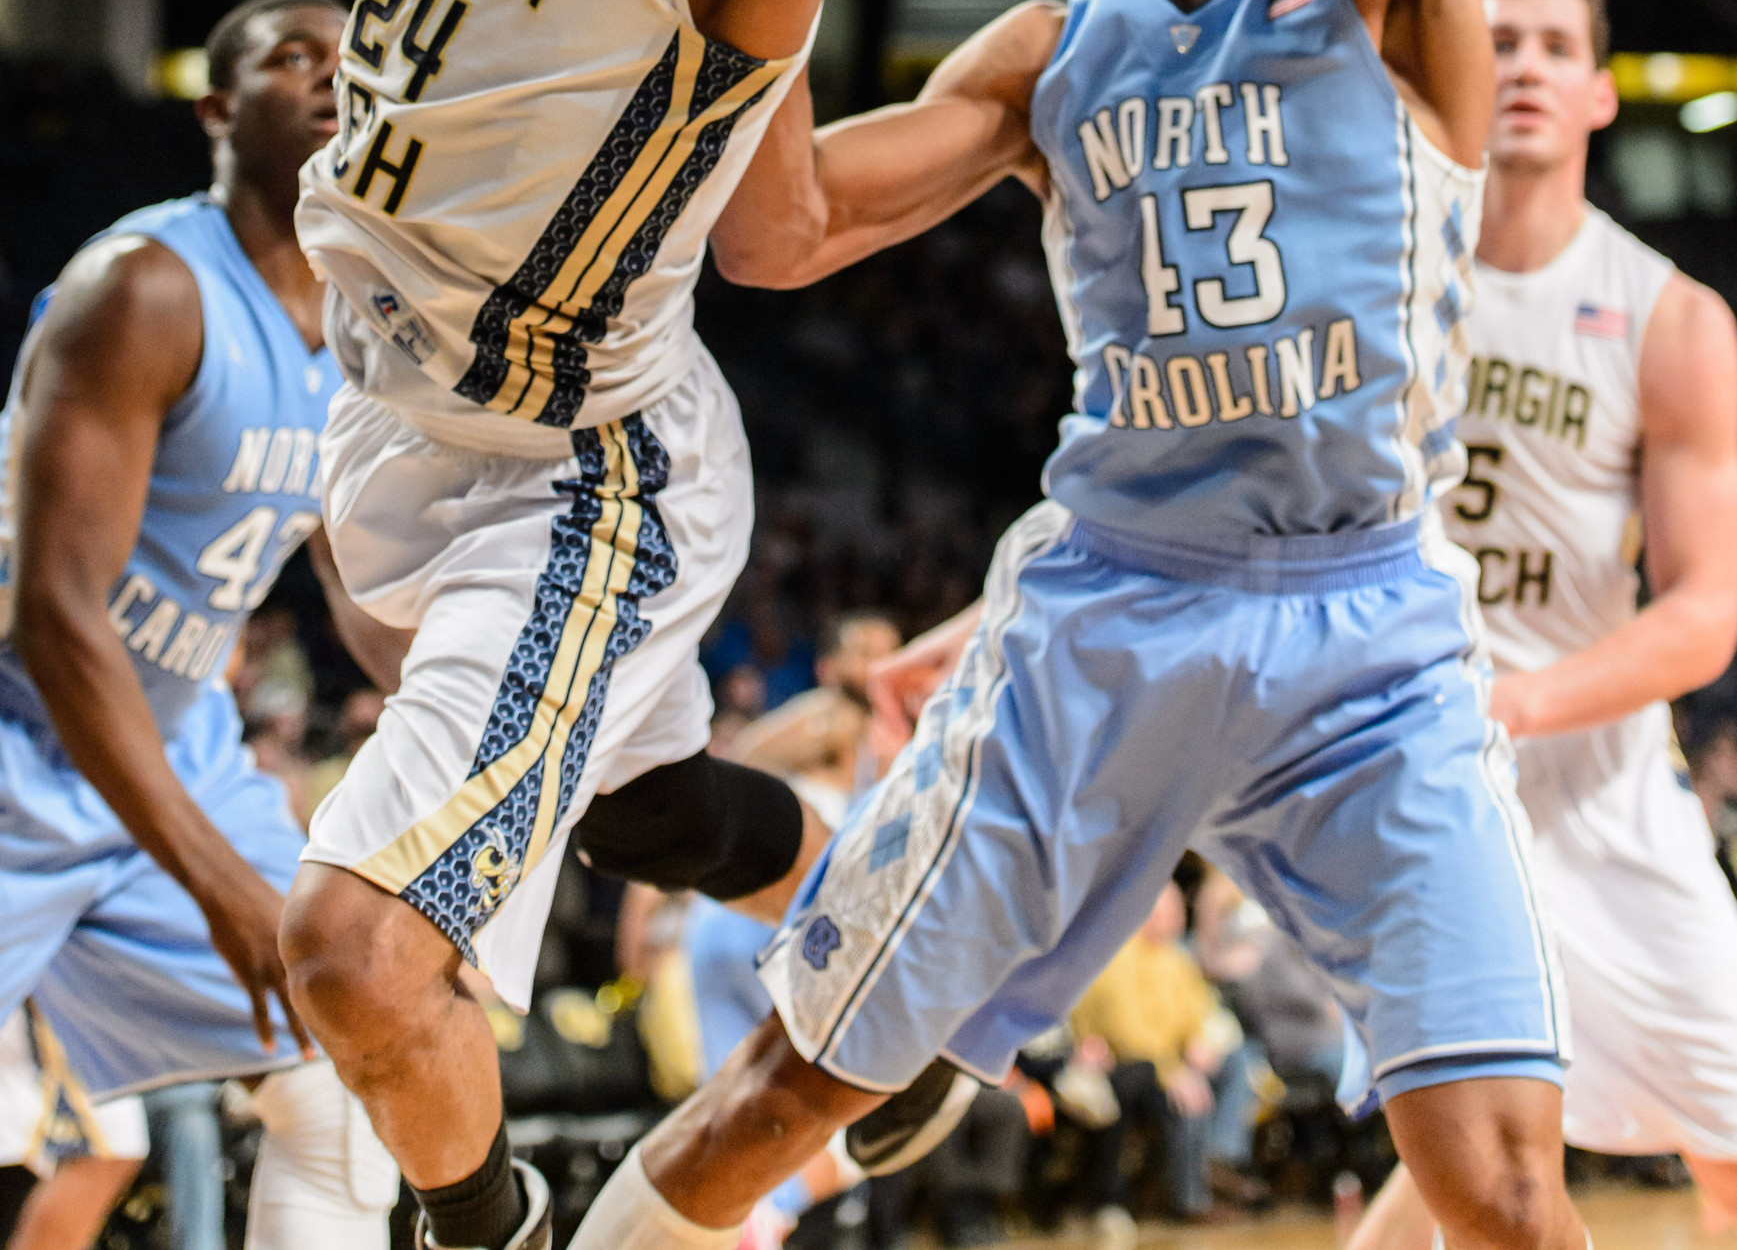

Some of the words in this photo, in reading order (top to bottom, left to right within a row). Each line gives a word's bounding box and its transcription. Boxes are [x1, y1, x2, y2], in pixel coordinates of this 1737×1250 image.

[1078, 81, 1289, 201] NORTH
[1454, 446, 1501, 522] 5
[1474, 550, 1552, 607] CH
